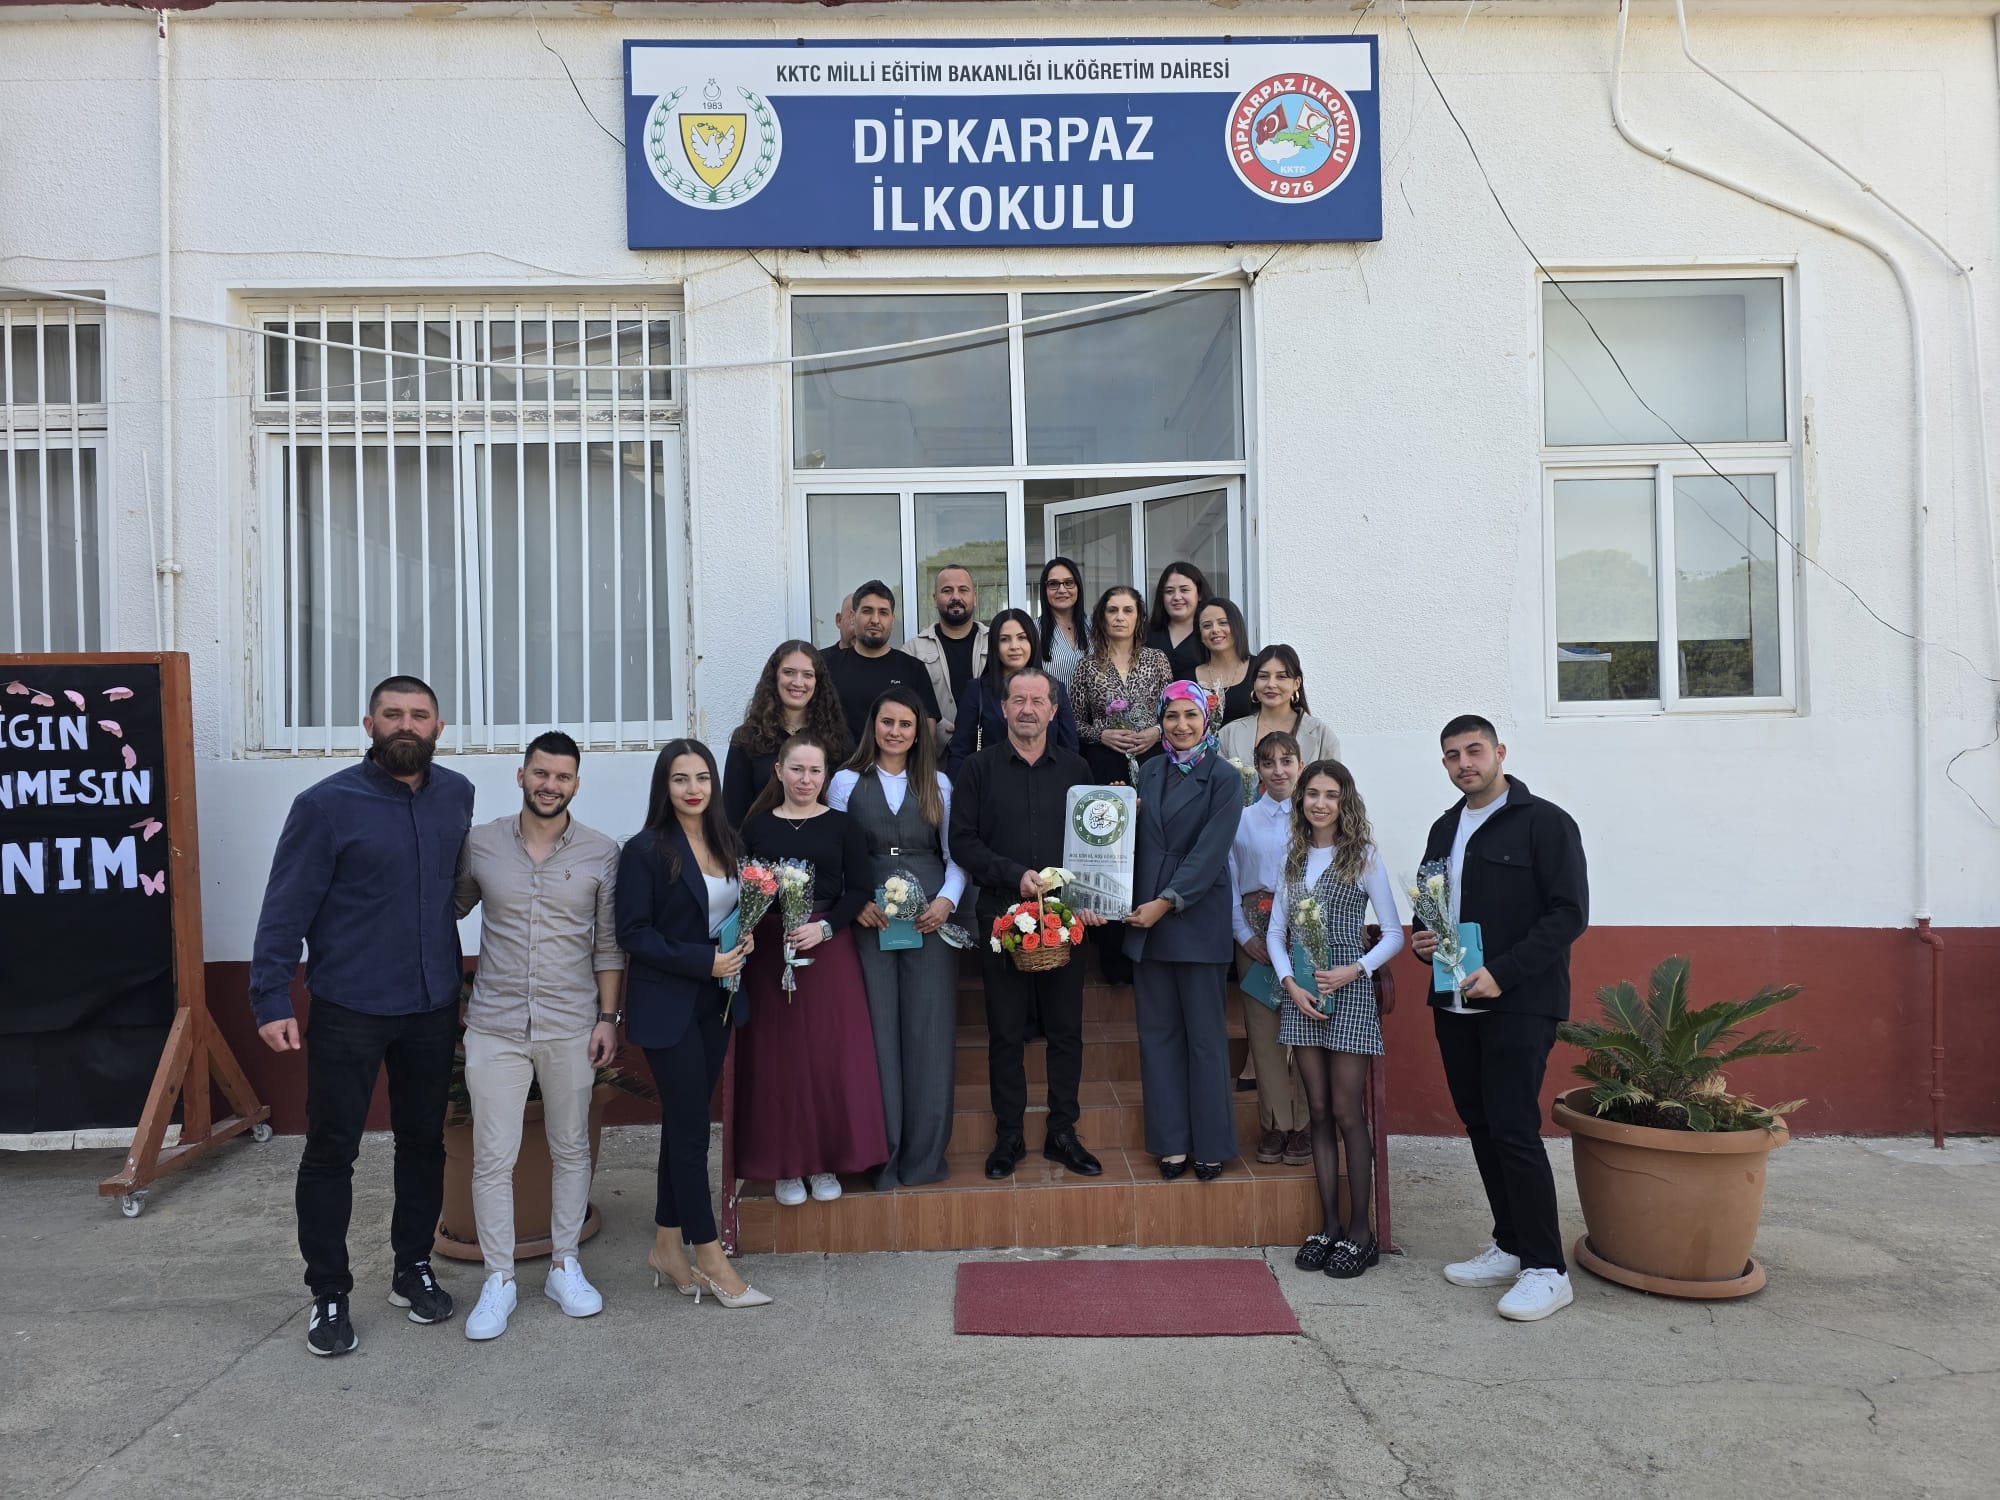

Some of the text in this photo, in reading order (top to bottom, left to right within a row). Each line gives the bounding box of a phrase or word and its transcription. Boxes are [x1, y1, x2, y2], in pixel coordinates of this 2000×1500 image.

[776, 58, 1229, 82] KKTC MİLLİ EĞİTİM BAKANLIĞI İLKÖĞRETİM DAİRESİ
[702, 102, 723, 110] 1983
[1234, 76, 1350, 164] DİPKARPAZ İLKOKULU
[854, 108, 1154, 163] DİPKARPAZ
[873, 175, 1134, 231] İLKOKULU
[1270, 180, 1315, 195] 1976
[2, 836, 137, 894] NIM
